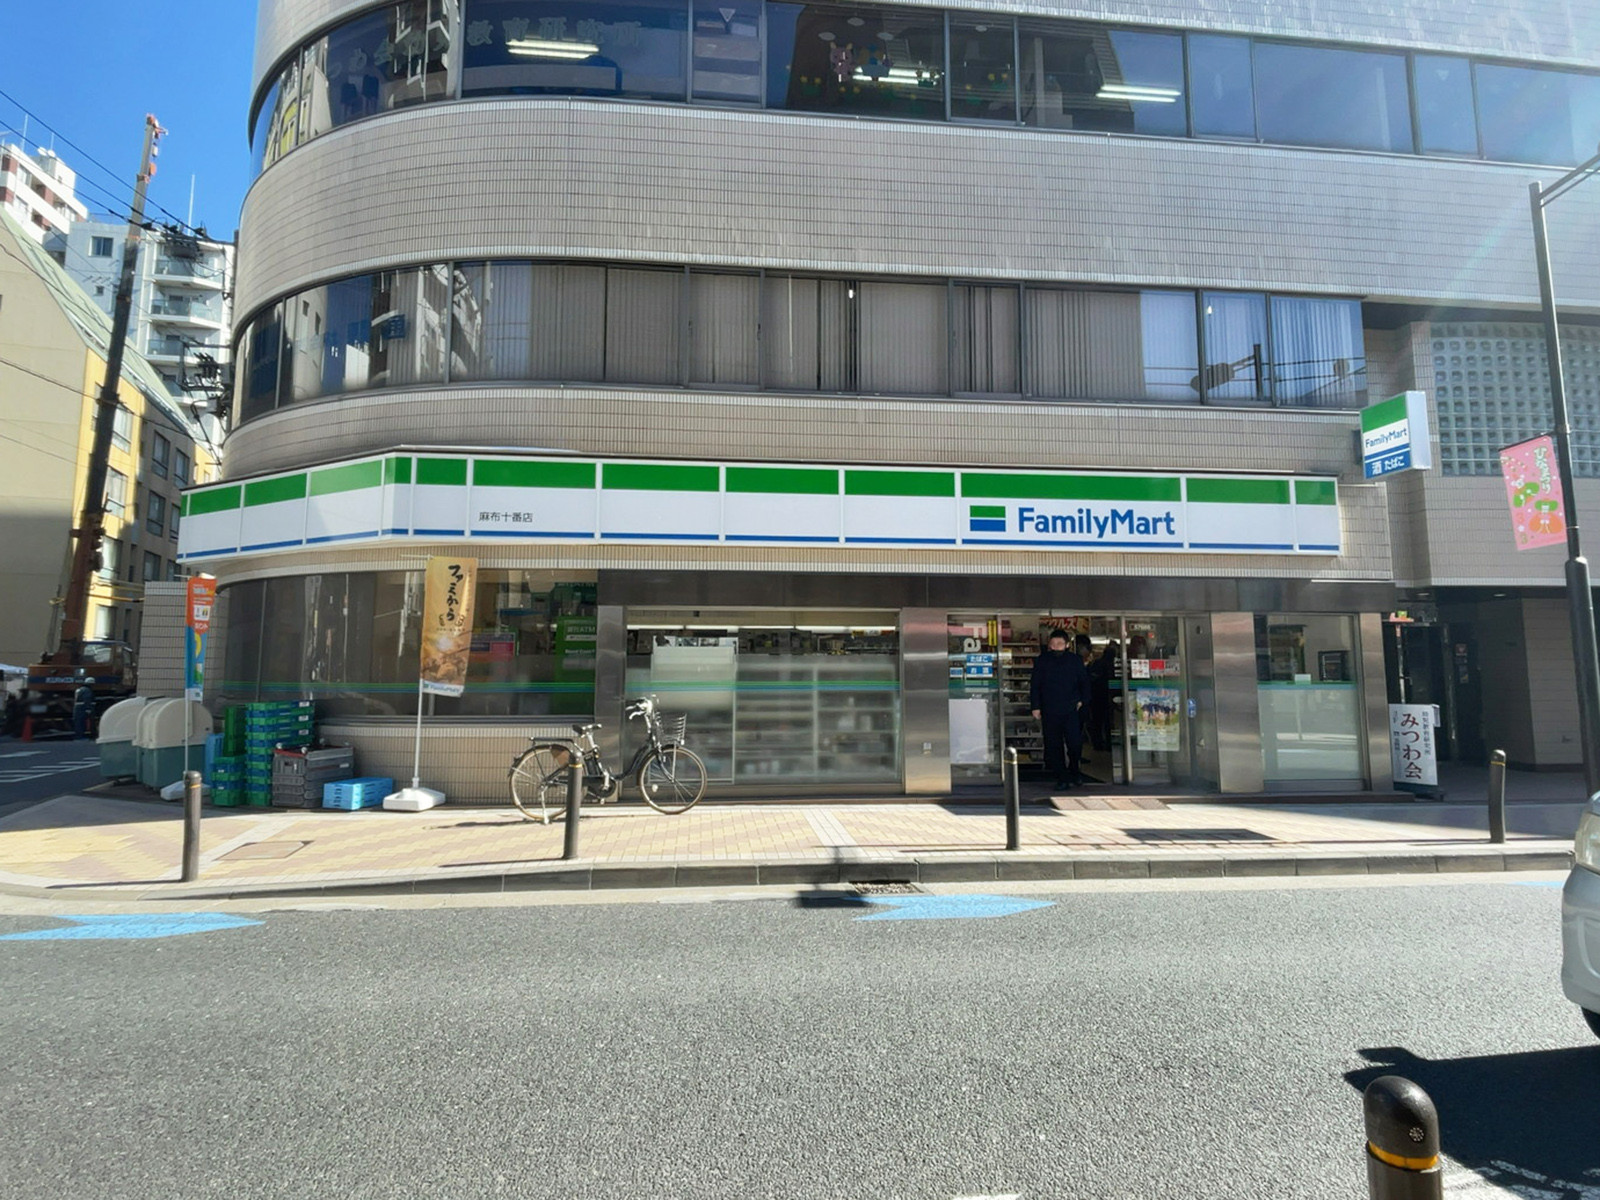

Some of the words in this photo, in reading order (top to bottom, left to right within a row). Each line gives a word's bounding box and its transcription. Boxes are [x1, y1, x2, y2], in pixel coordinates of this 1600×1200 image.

[1365, 428, 1407, 448] FamilyMart
[478, 511, 534, 523] 麻布十番店
[1018, 507, 1175, 539] FamilyMart
[446, 564, 464, 621] ファミから
[1400, 713, 1422, 780] みつわ会
